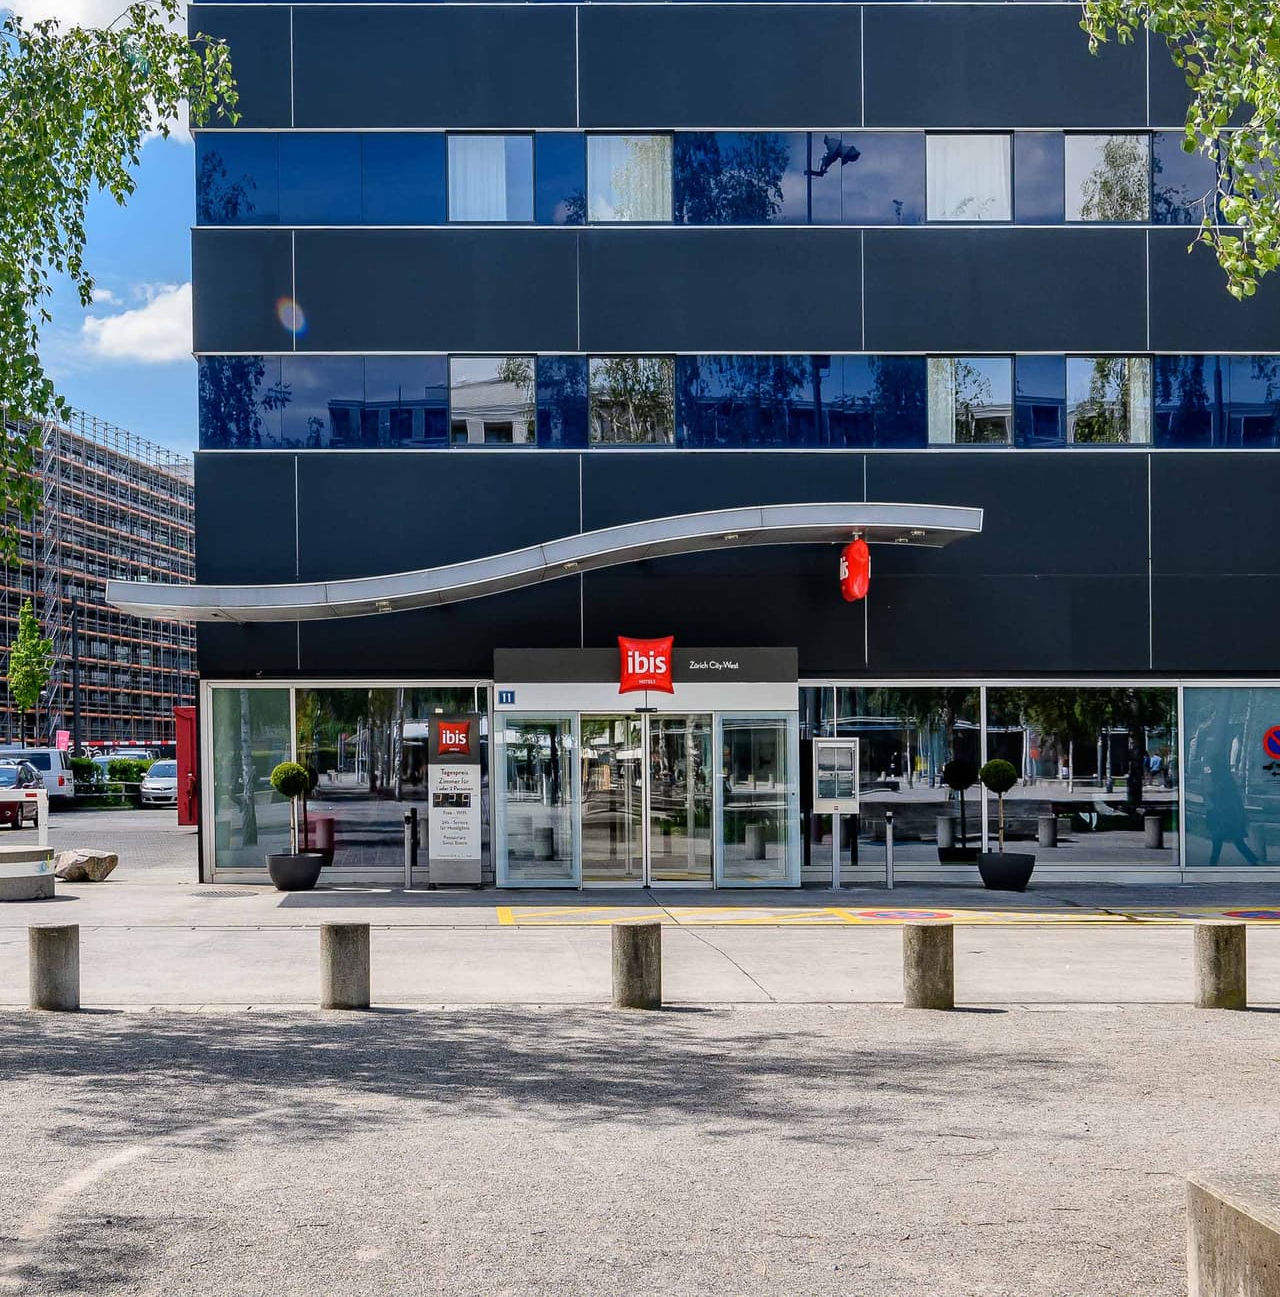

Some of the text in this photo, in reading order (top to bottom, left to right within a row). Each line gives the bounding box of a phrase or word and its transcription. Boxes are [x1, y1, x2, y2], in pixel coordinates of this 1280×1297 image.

[627, 651, 667, 674] ibis
[689, 661, 708, 669] Zürich
[503, 693, 511, 703] 11
[442, 730, 466, 744] ibis
